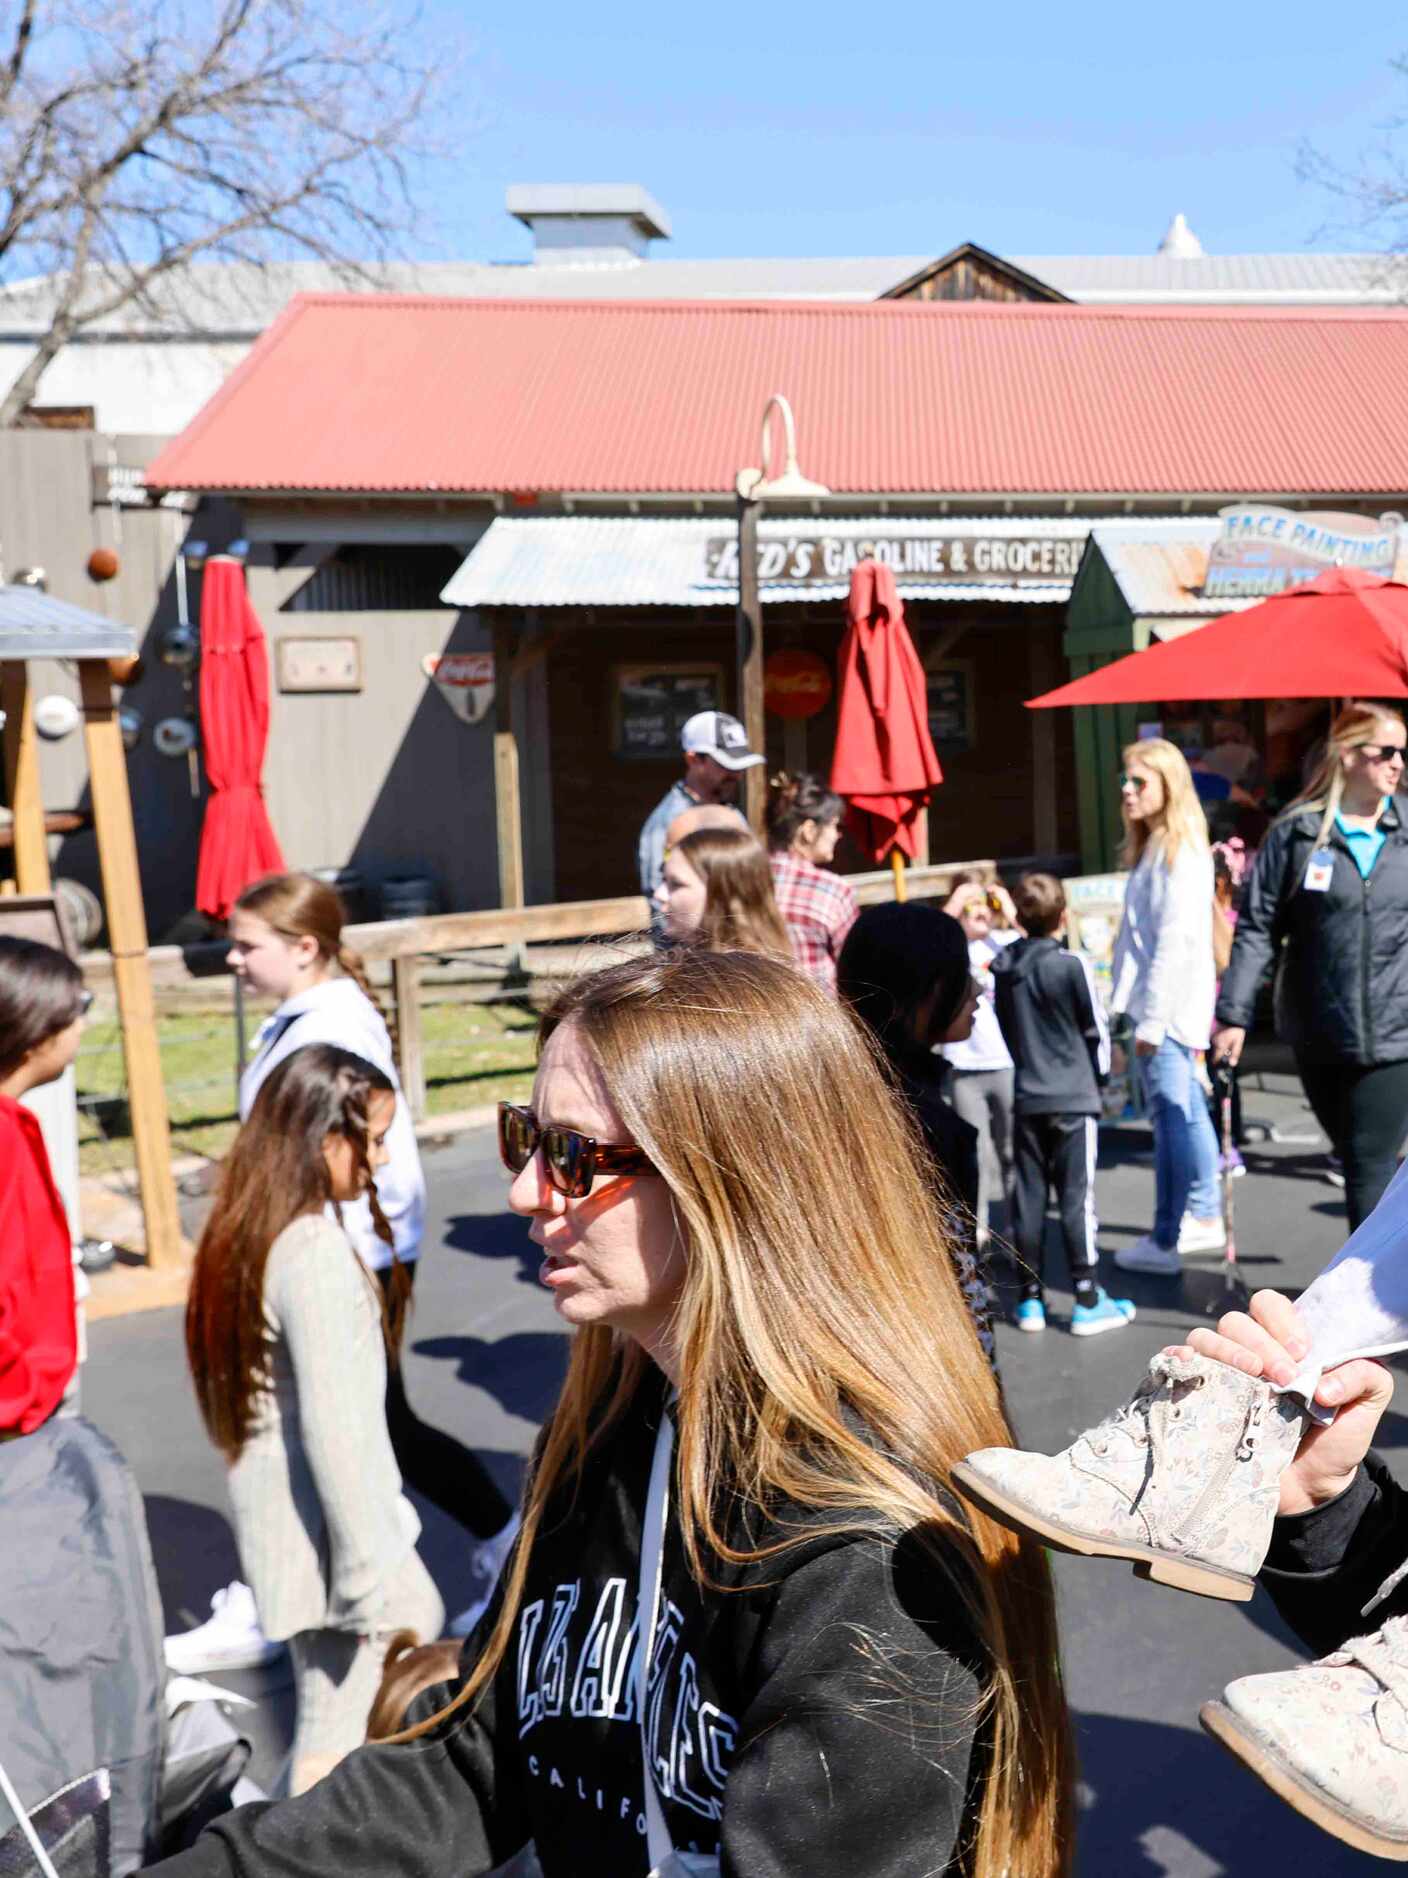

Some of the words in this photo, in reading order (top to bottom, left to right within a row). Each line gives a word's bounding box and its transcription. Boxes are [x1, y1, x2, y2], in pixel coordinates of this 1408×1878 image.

[949, 539, 967, 573] &
[1226, 514, 1288, 538] FACE
[1291, 522, 1389, 562] PAINTING
